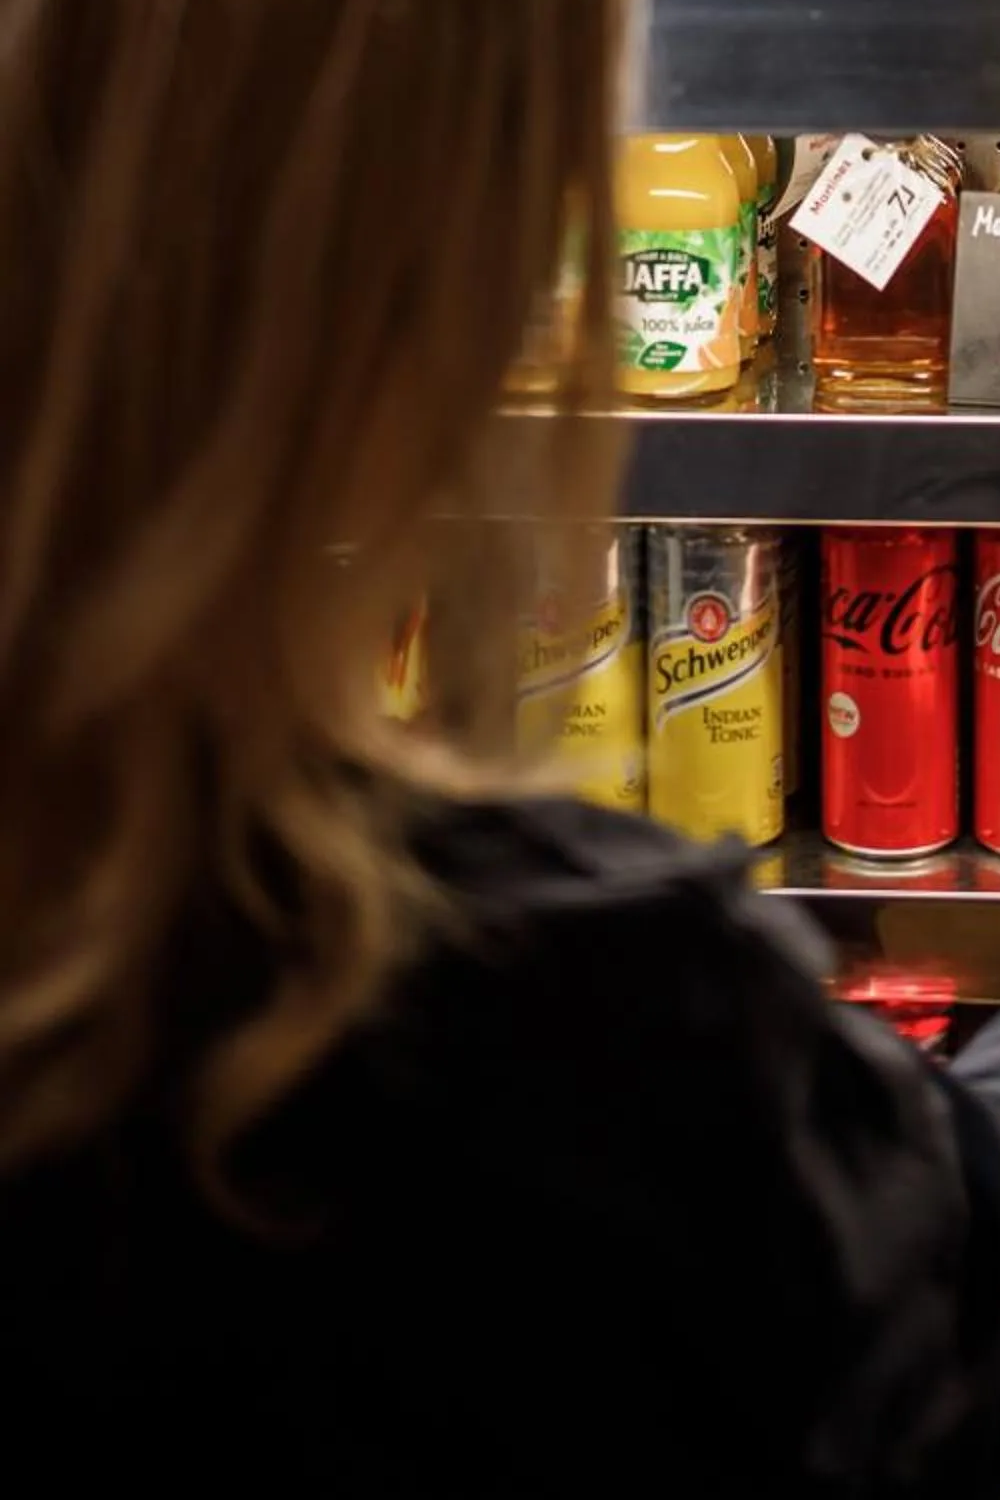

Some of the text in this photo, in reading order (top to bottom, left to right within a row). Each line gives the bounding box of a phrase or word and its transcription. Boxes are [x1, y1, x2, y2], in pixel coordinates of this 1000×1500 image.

[624, 260, 703, 292] JAFFA
[703, 706, 762, 725] INDIAN
[705, 725, 760, 744] TONIC
